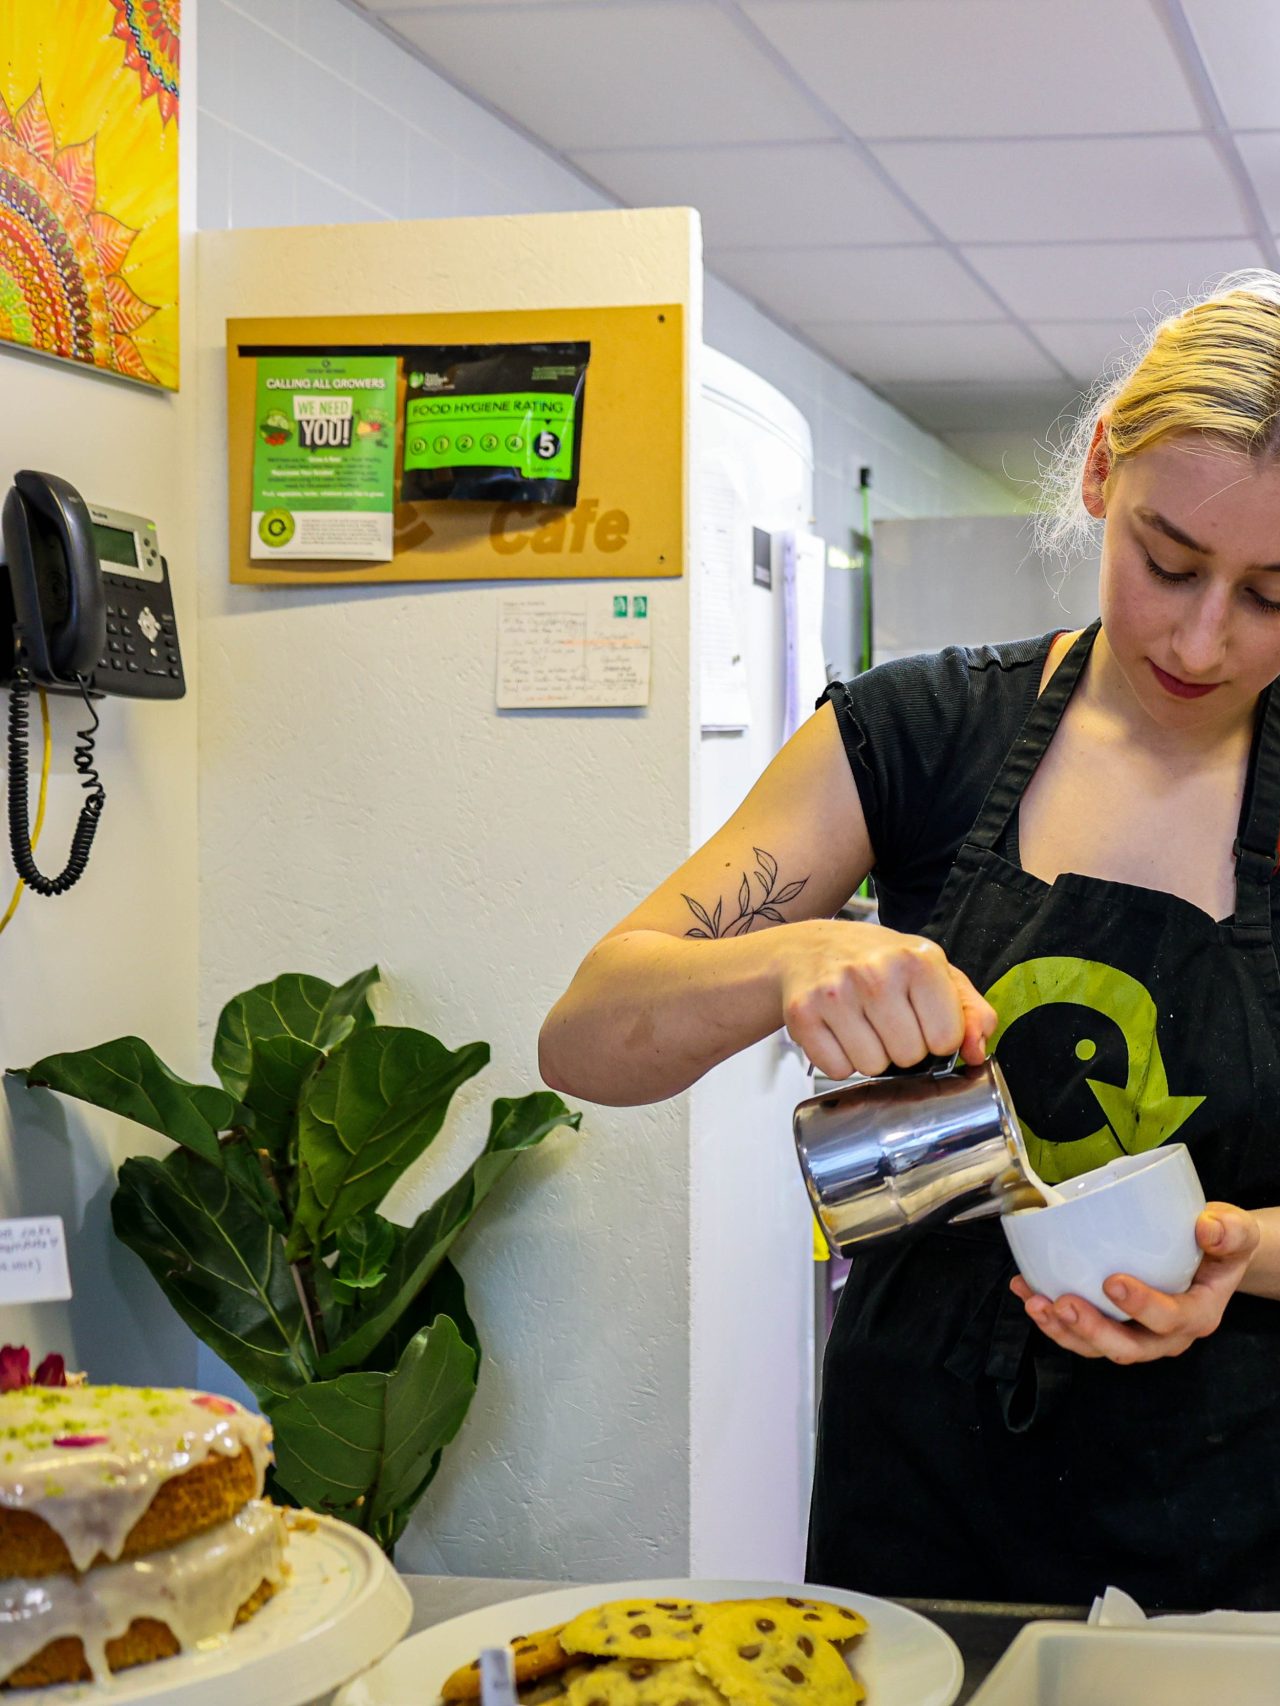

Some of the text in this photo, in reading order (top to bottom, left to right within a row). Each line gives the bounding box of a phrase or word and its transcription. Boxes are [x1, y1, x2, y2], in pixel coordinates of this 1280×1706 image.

[266, 378, 386, 390] CALLING ALL GROWERS
[297, 400, 349, 417] WE NEED
[412, 400, 564, 416] FOOD HYGIENE RATING
[302, 419, 350, 446] YOU!
[538, 430, 556, 458] 5
[489, 498, 630, 556] Cafe
